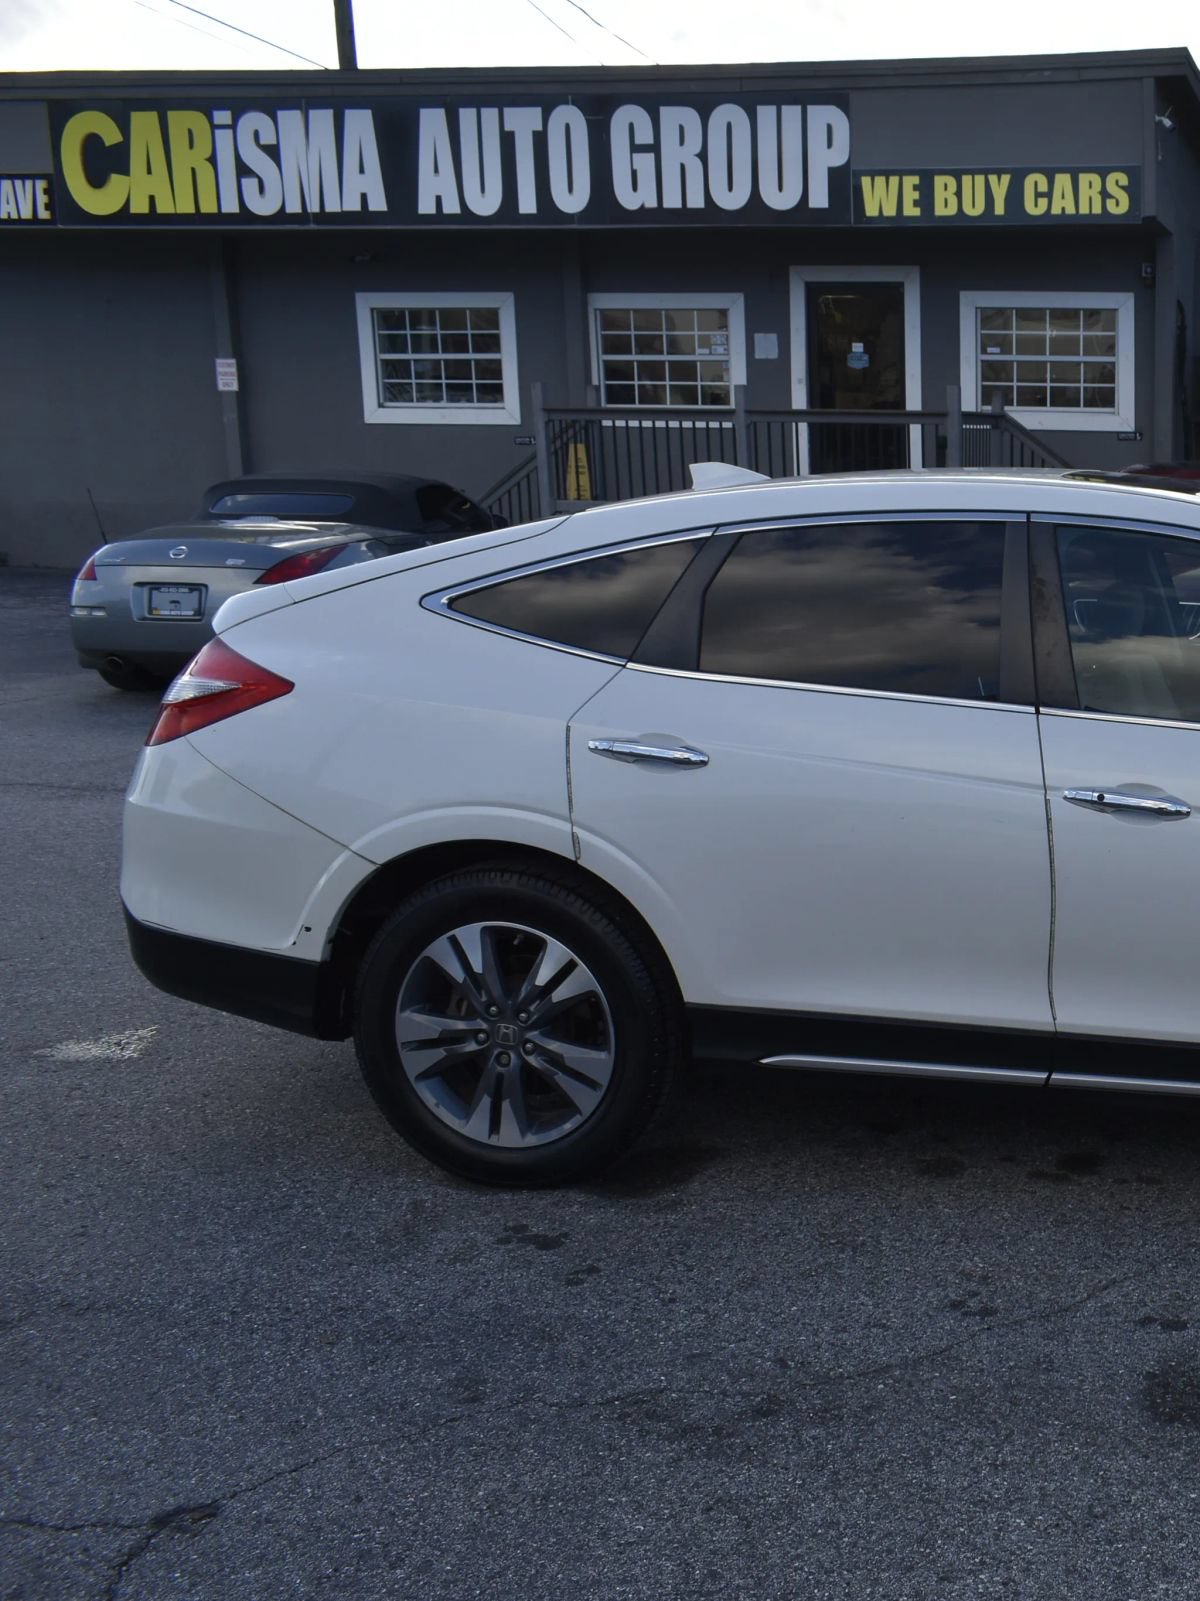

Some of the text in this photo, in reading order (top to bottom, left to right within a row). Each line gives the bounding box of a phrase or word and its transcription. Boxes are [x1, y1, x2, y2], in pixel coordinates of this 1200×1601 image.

[417, 104, 591, 216] AUTO
[609, 103, 850, 211] GROUP
[0, 179, 52, 220] AVE
[861, 171, 1130, 217] WE BUY CARS
